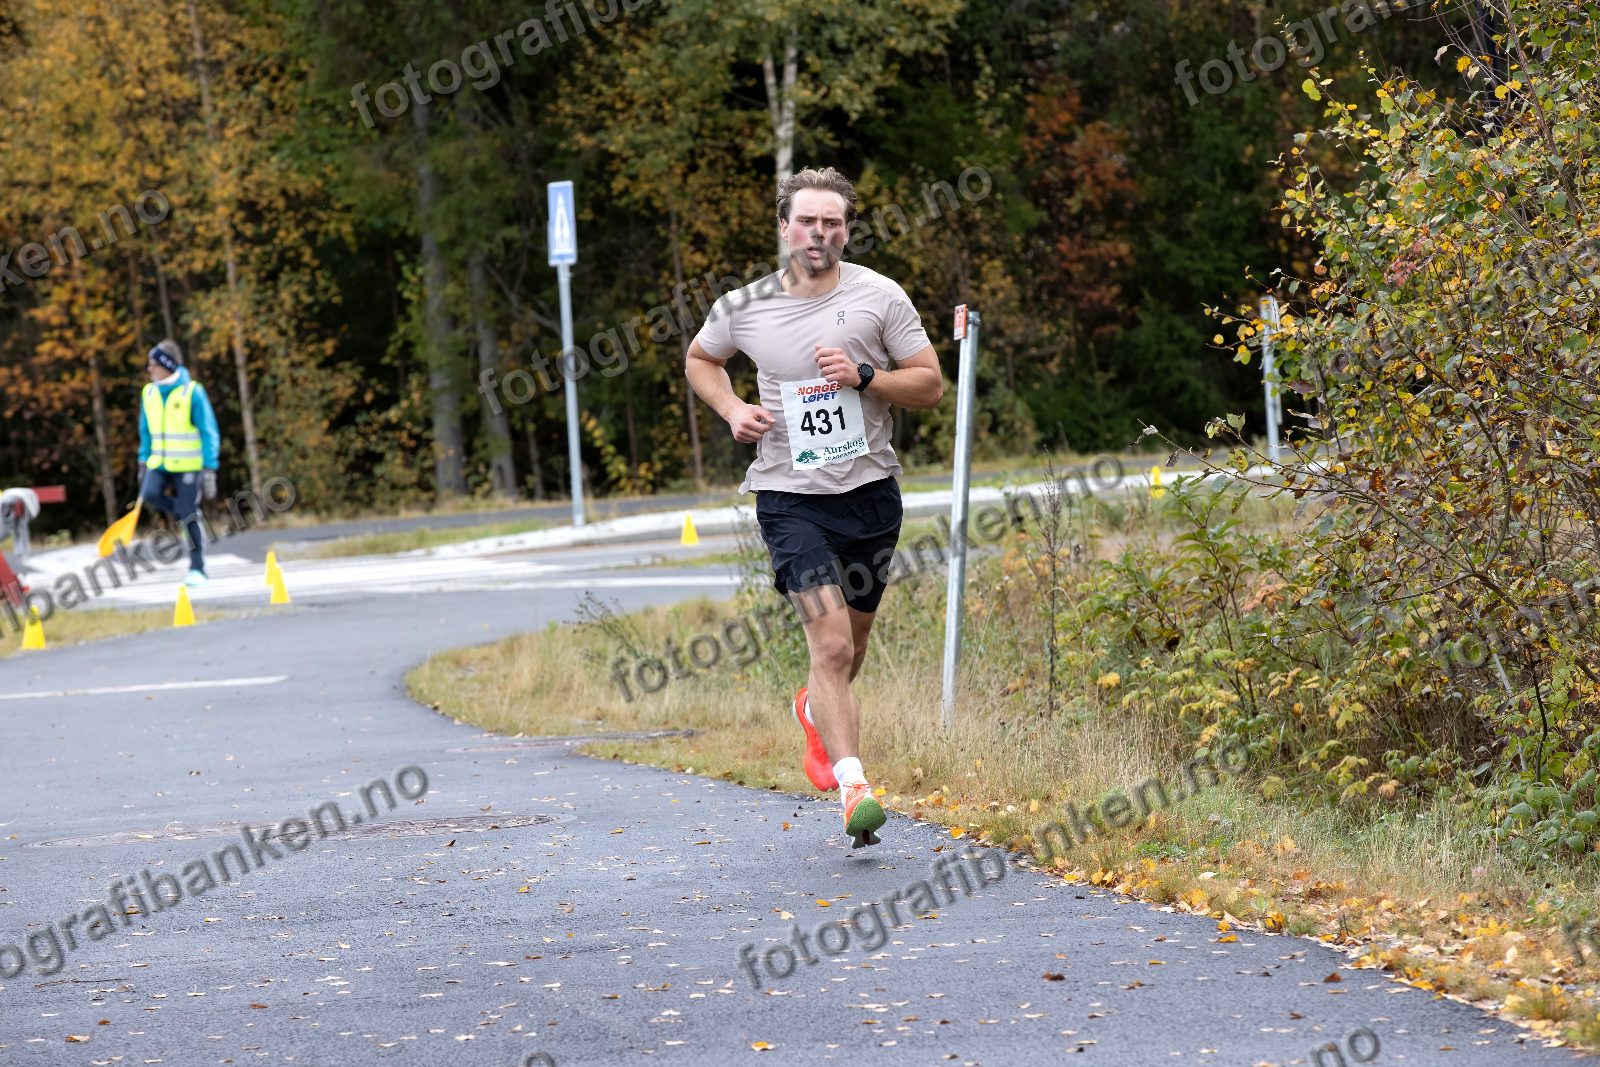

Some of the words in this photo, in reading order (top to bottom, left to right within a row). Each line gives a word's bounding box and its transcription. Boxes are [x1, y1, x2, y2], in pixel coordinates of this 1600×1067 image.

[797, 382, 843, 396] NORGES
[802, 391, 838, 404] LØPET
[800, 405, 846, 436] 431
[824, 437, 865, 456] Aurskog
